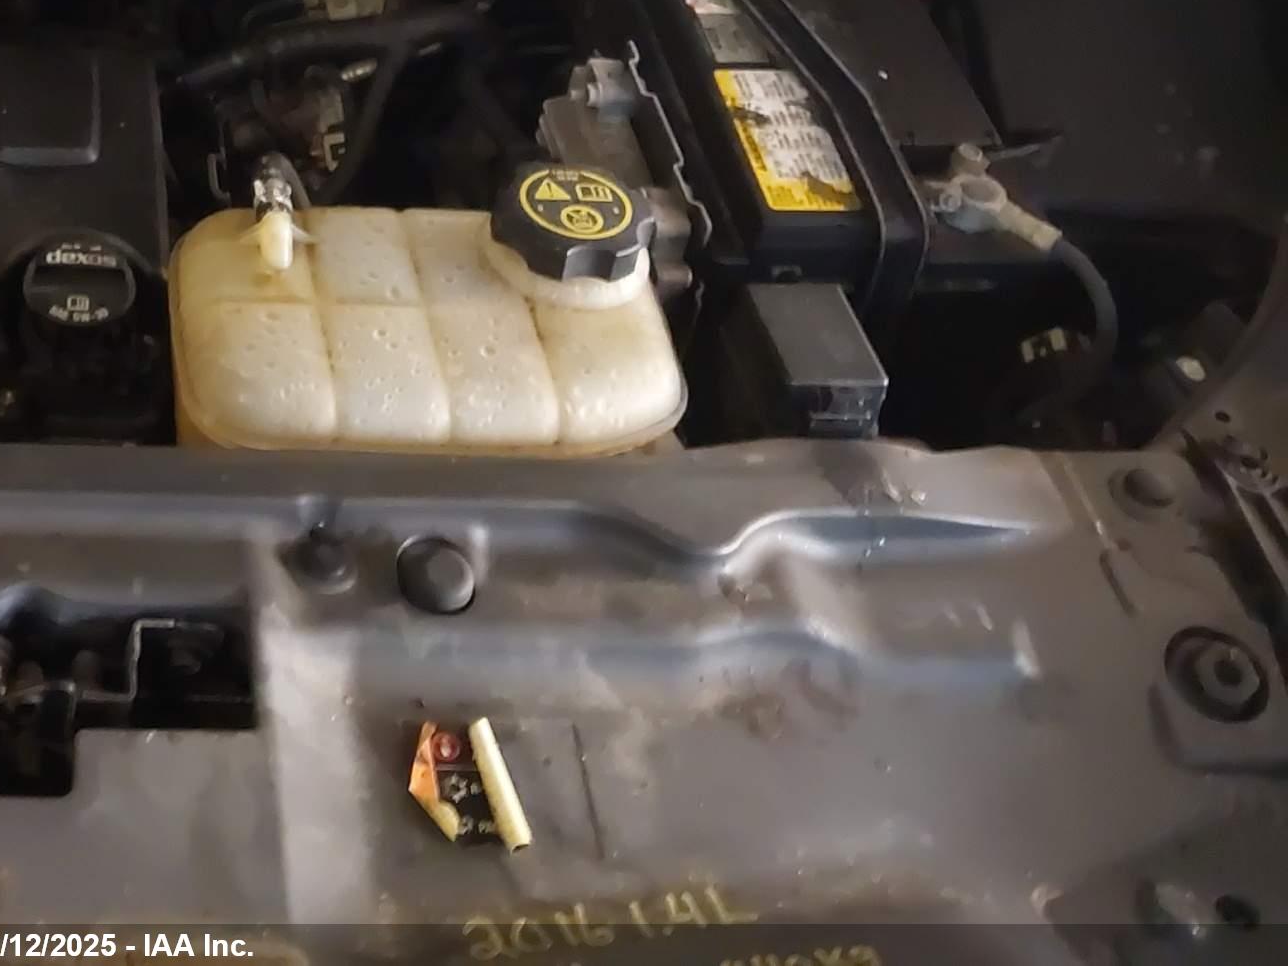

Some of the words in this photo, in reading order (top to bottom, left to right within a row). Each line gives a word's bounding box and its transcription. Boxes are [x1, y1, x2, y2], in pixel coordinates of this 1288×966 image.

[46, 249, 117, 267] dexos
[462, 901, 616, 962] 2016
[628, 885, 759, 939] 1.4L
